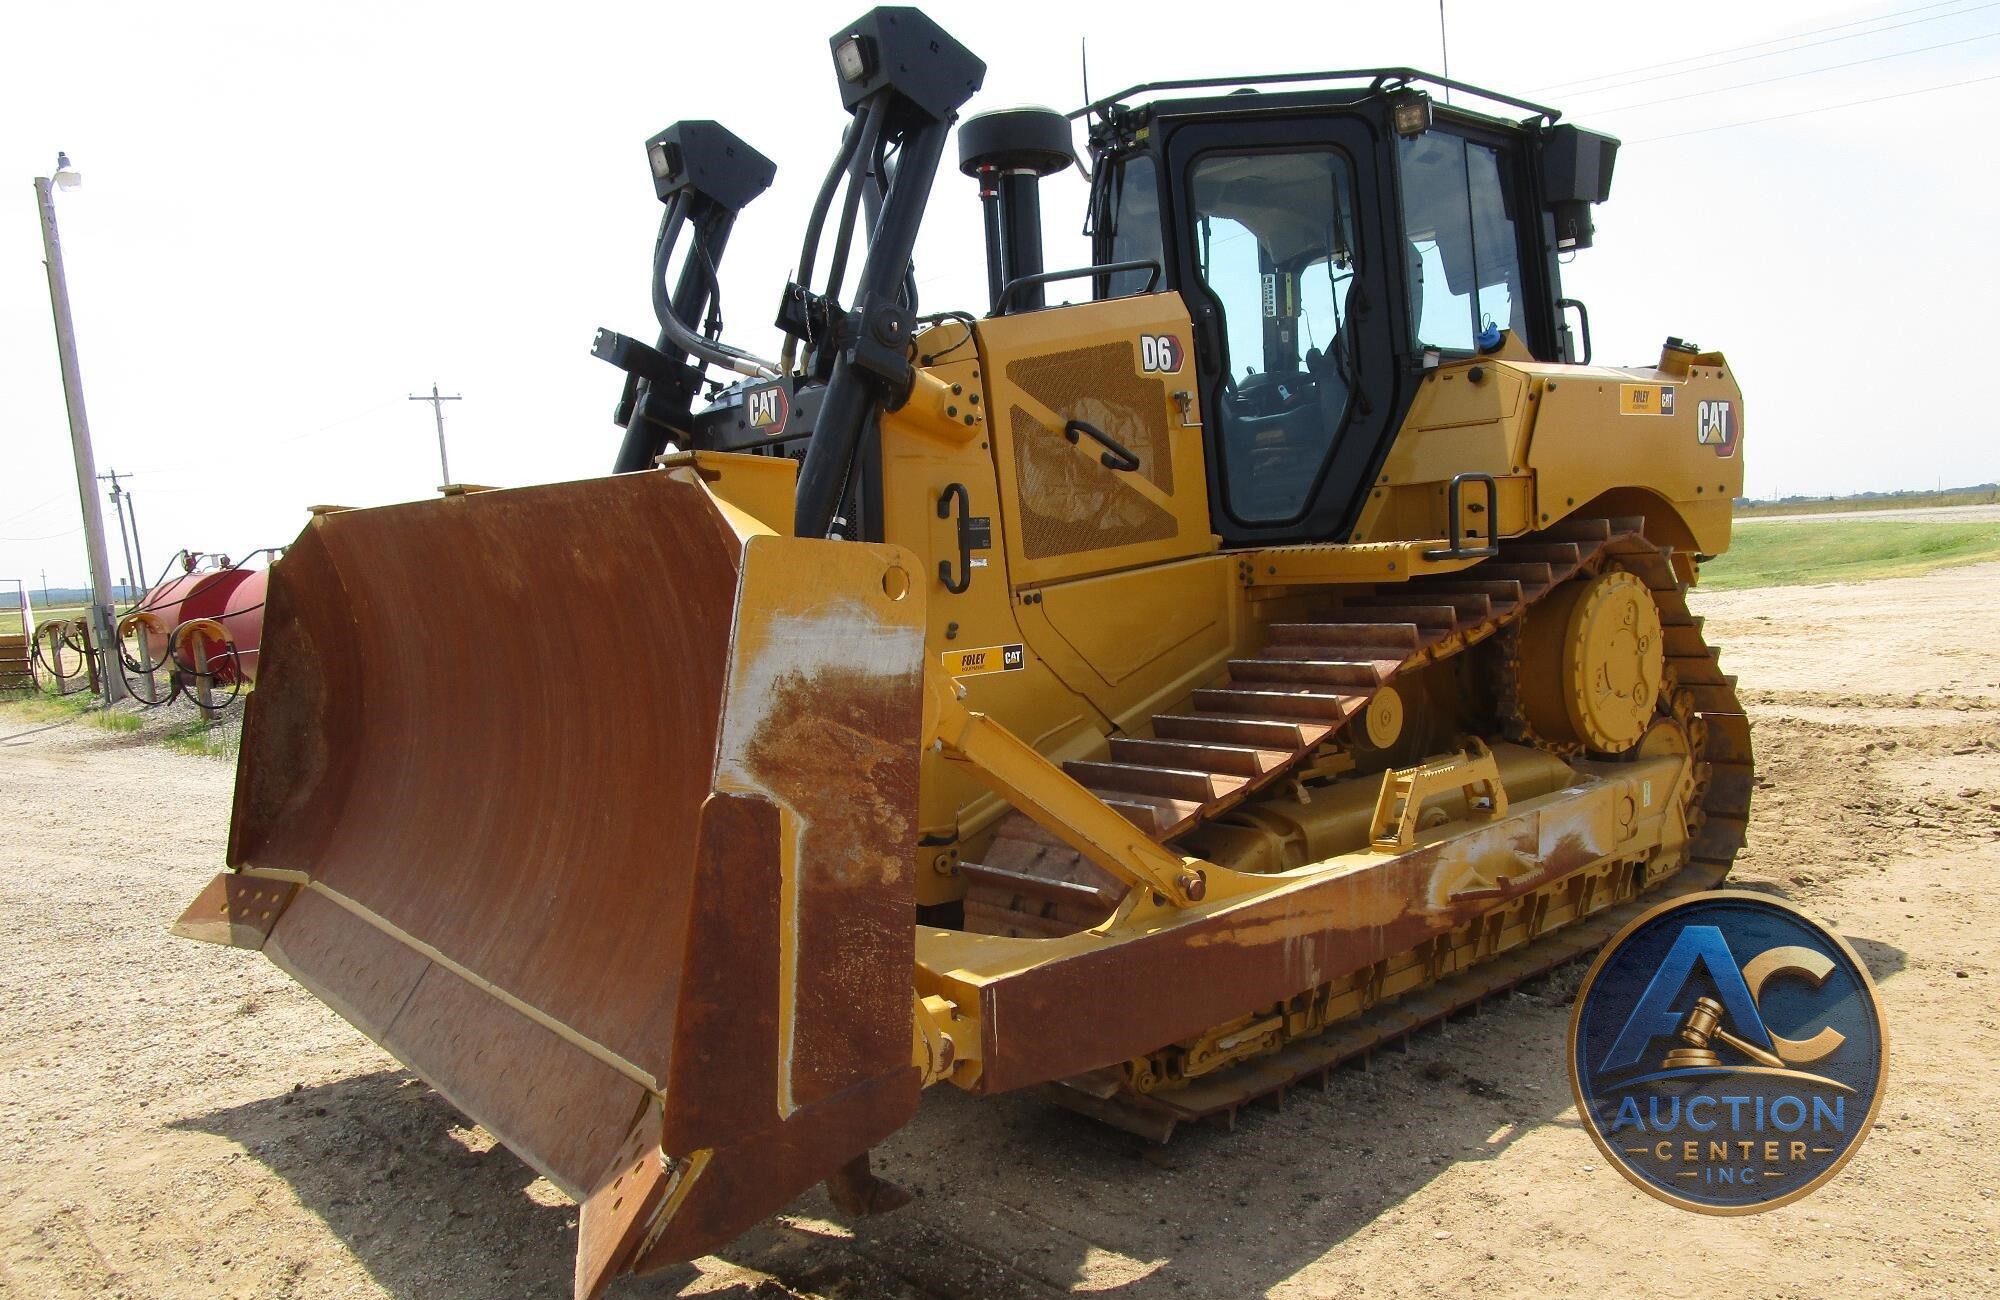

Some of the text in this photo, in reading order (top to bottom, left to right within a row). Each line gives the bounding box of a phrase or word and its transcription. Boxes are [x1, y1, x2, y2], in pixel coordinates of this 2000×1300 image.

[1141, 336, 1172, 371] D6
[750, 389, 778, 427] CAT
[1661, 393, 1673, 408] CAT
[1698, 401, 1729, 444] CAT
[961, 651, 1021, 667] FOLEY CAT
